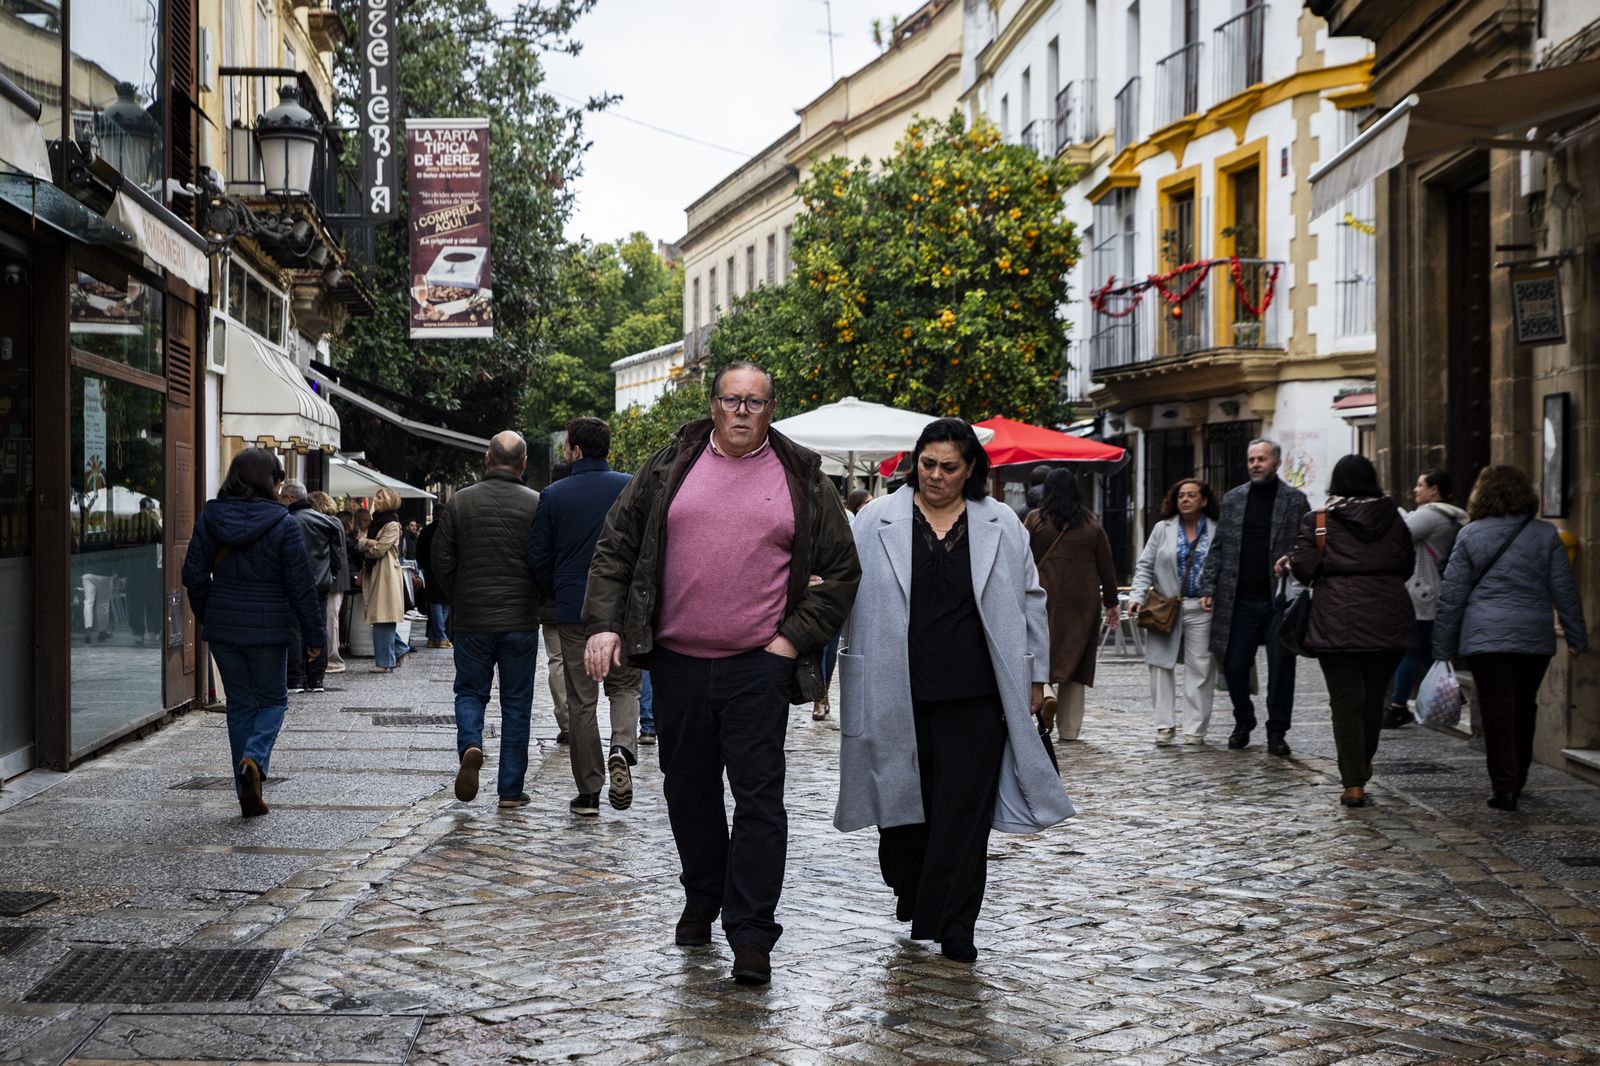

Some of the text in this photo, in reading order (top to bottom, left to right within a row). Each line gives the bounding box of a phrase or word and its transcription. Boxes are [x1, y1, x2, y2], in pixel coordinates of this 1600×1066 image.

[414, 130, 479, 142] LA TARTA
[424, 139, 469, 154] TÍPICA
[414, 153, 480, 166] DE JEREZ
